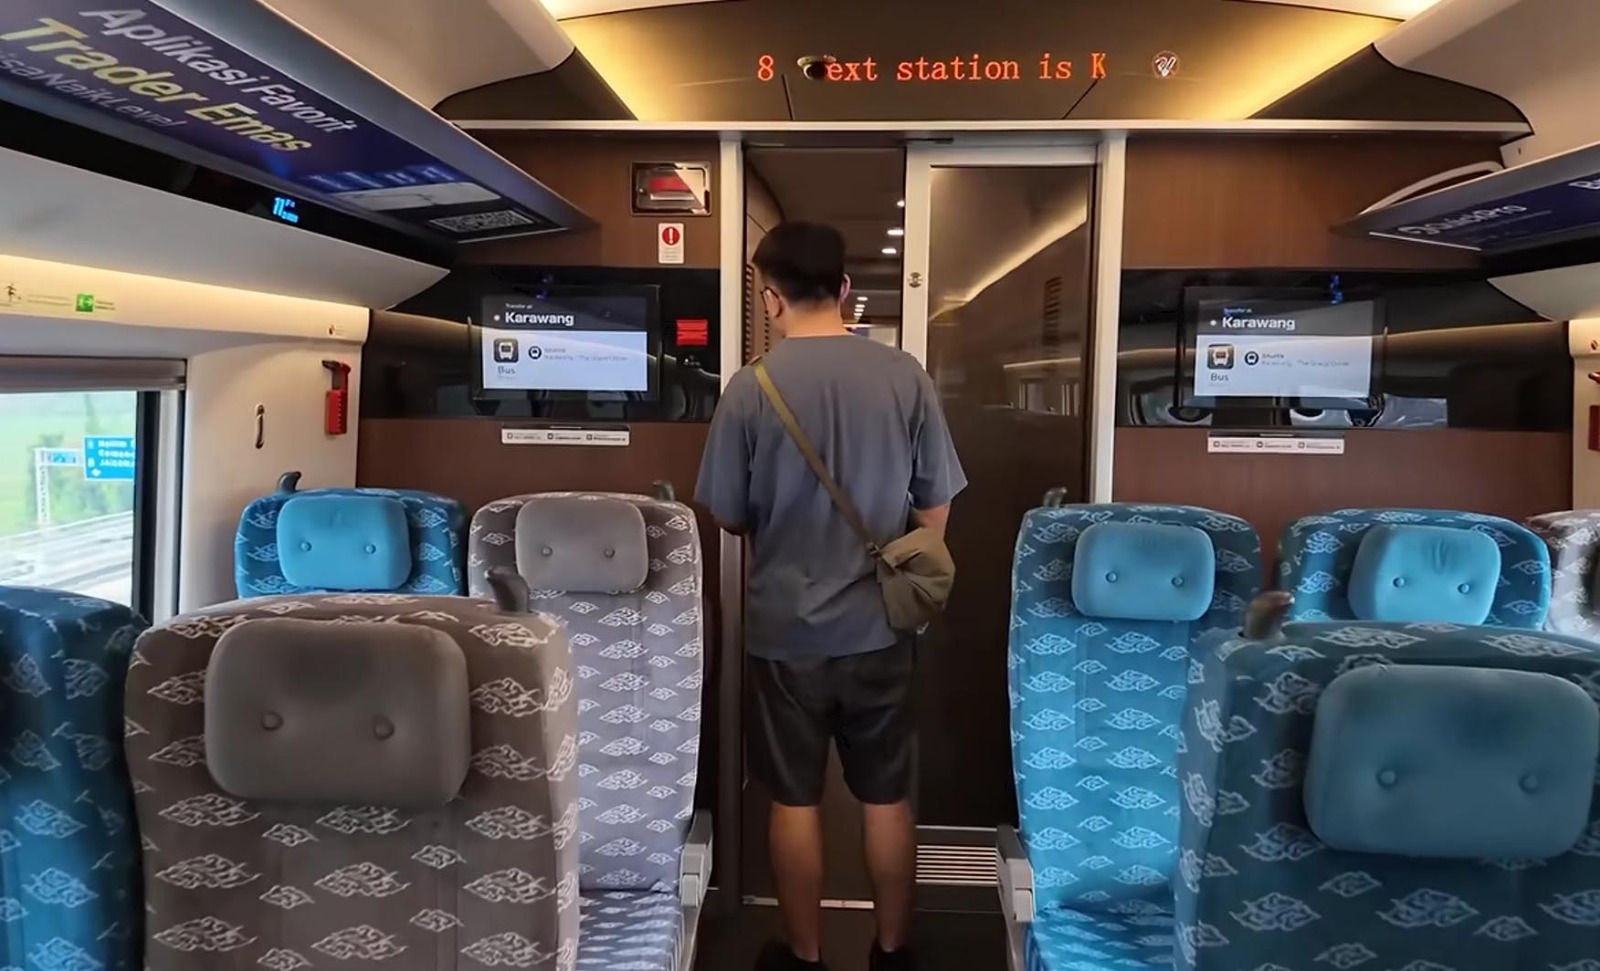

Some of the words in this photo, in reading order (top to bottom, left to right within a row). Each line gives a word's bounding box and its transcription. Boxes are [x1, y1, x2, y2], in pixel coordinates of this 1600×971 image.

[79, 9, 269, 85] Aplikasi
[242, 84, 357, 132] Favorit
[758, 54, 774, 81] 8
[822, 55, 878, 81] ext
[897, 53, 1020, 81] station
[1039, 52, 1072, 80] is
[1090, 52, 1107, 80] K
[0, 18, 209, 102] Trader
[185, 103, 312, 151] Emas
[505, 312, 574, 326] Karawang
[1222, 317, 1295, 331] Karawang
[498, 365, 515, 375] Bus
[1210, 372, 1229, 381] Bus
